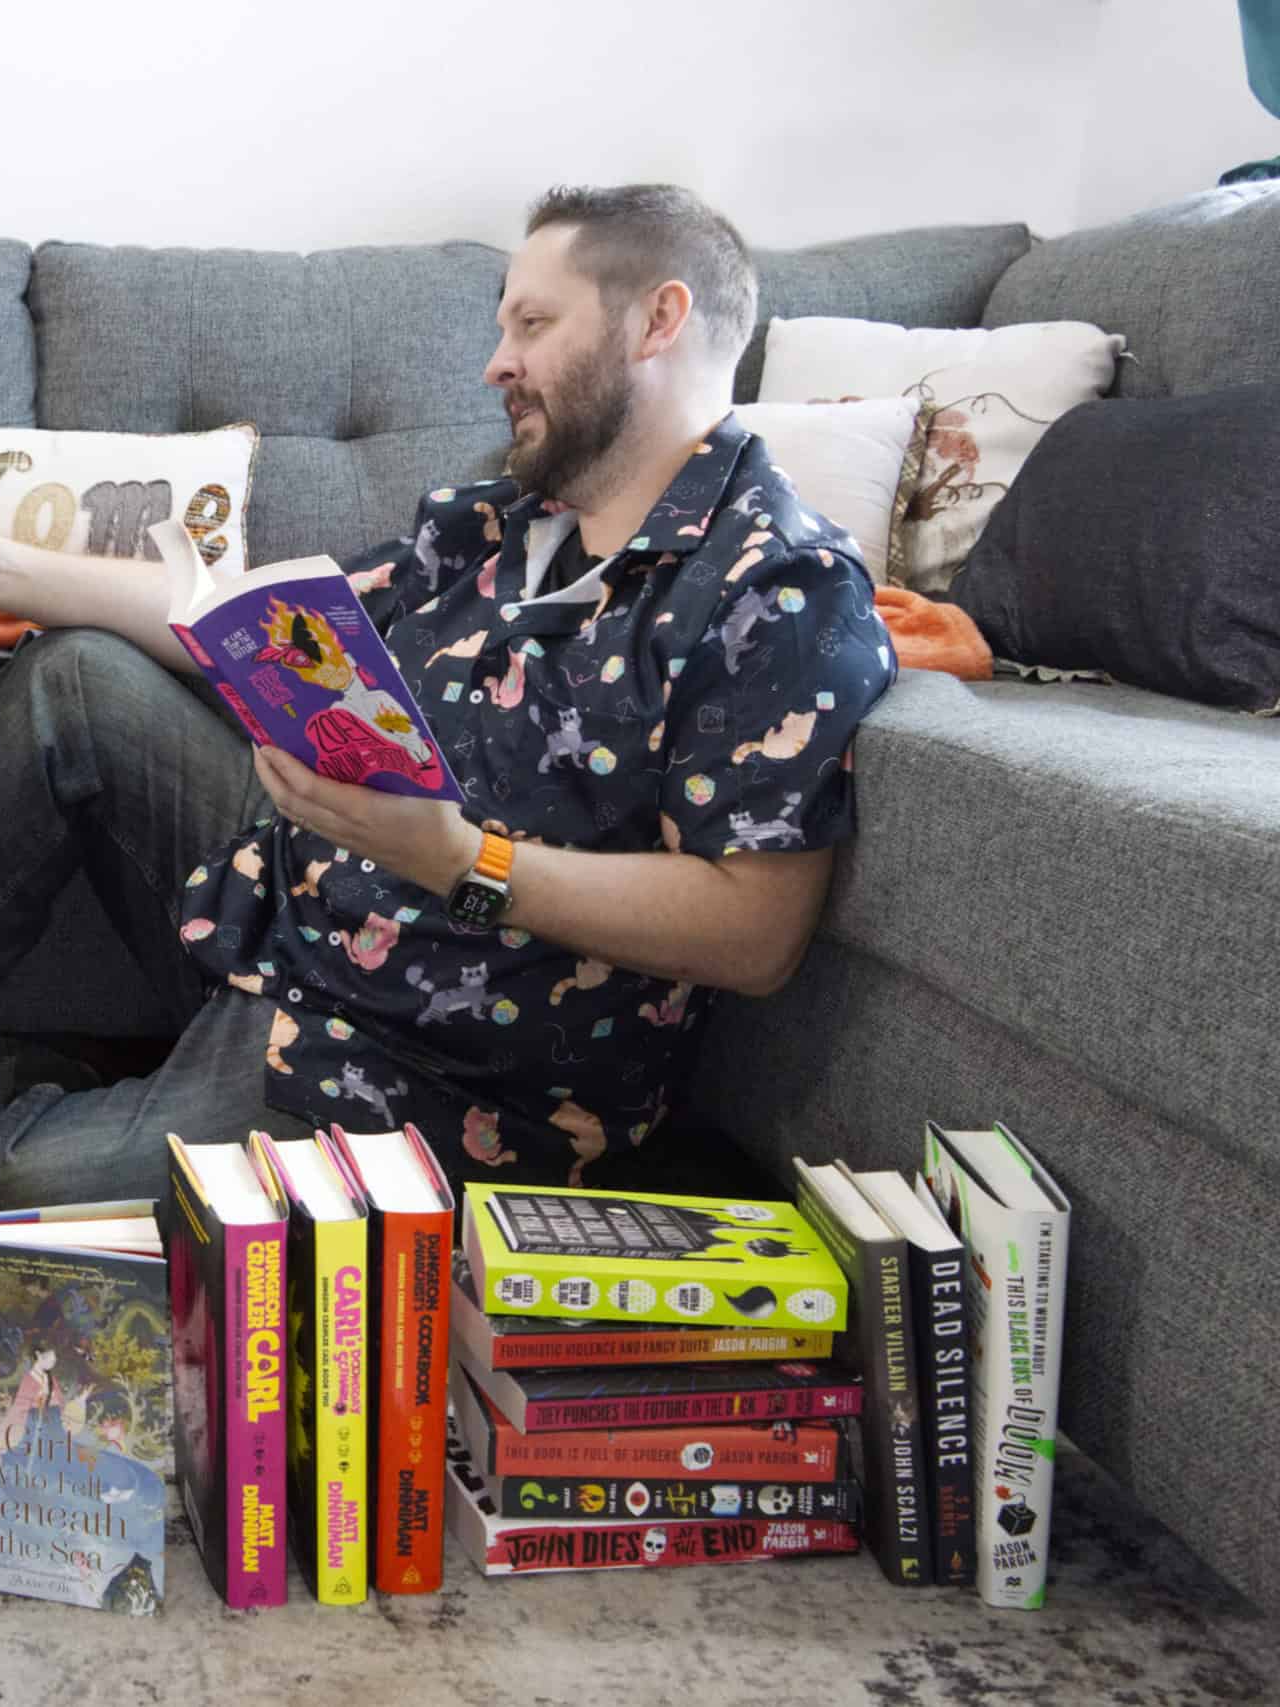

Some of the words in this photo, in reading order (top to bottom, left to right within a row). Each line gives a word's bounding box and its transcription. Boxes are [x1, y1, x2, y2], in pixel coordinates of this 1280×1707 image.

[308, 711, 387, 754] ZOEY
[1039, 1221, 1053, 1239] I'M
[246, 1240, 265, 1329] CRAWLER
[264, 1239, 281, 1328] DUNGEON
[426, 1233, 440, 1312] DUNGEON
[1035, 1240, 1052, 1290] STARTING
[880, 1256, 902, 1321] STARTER
[932, 1260, 962, 1337] DEAD
[1006, 1275, 1026, 1309] THIS
[1034, 1291, 1050, 1305] TO
[712, 1336, 746, 1353] JASON
[1007, 1310, 1030, 1355] BLACK
[1033, 1306, 1049, 1342] WORRY
[247, 1329, 281, 1424] CARL
[416, 1314, 433, 1407] COOKBOOK
[885, 1323, 908, 1393] VILLAIN
[1010, 1356, 1033, 1385] BOX
[1031, 1344, 1046, 1377] ABOUT
[563, 1403, 619, 1422] PUNCHES
[643, 1400, 690, 1420] FUTURE
[934, 1348, 968, 1467] SILENCE
[1017, 1387, 1034, 1405] OF
[5, 1423, 73, 1466] Girl
[893, 1438, 912, 1480] JOHN
[993, 1403, 1047, 1488] DOOM
[58, 1471, 101, 1502] Fell
[242, 1484, 261, 1574] DINNIMAN
[257, 1503, 276, 1549] MATT
[326, 1480, 345, 1570] DINNIMAN
[343, 1500, 359, 1545] MATT
[395, 1468, 413, 1557] DINNIMAN
[410, 1487, 429, 1534] MATT
[766, 1523, 807, 1537] JASON
[896, 1482, 920, 1543] SCALZI
[0, 1529, 41, 1560] the
[49, 1539, 103, 1572] Sea
[503, 1532, 576, 1567] JOHN
[581, 1527, 641, 1564] DIES
[703, 1525, 757, 1556] END
[762, 1535, 810, 1550] PARGIN
[992, 1549, 1038, 1571] PARGIN
[993, 1541, 1031, 1557] JASON
